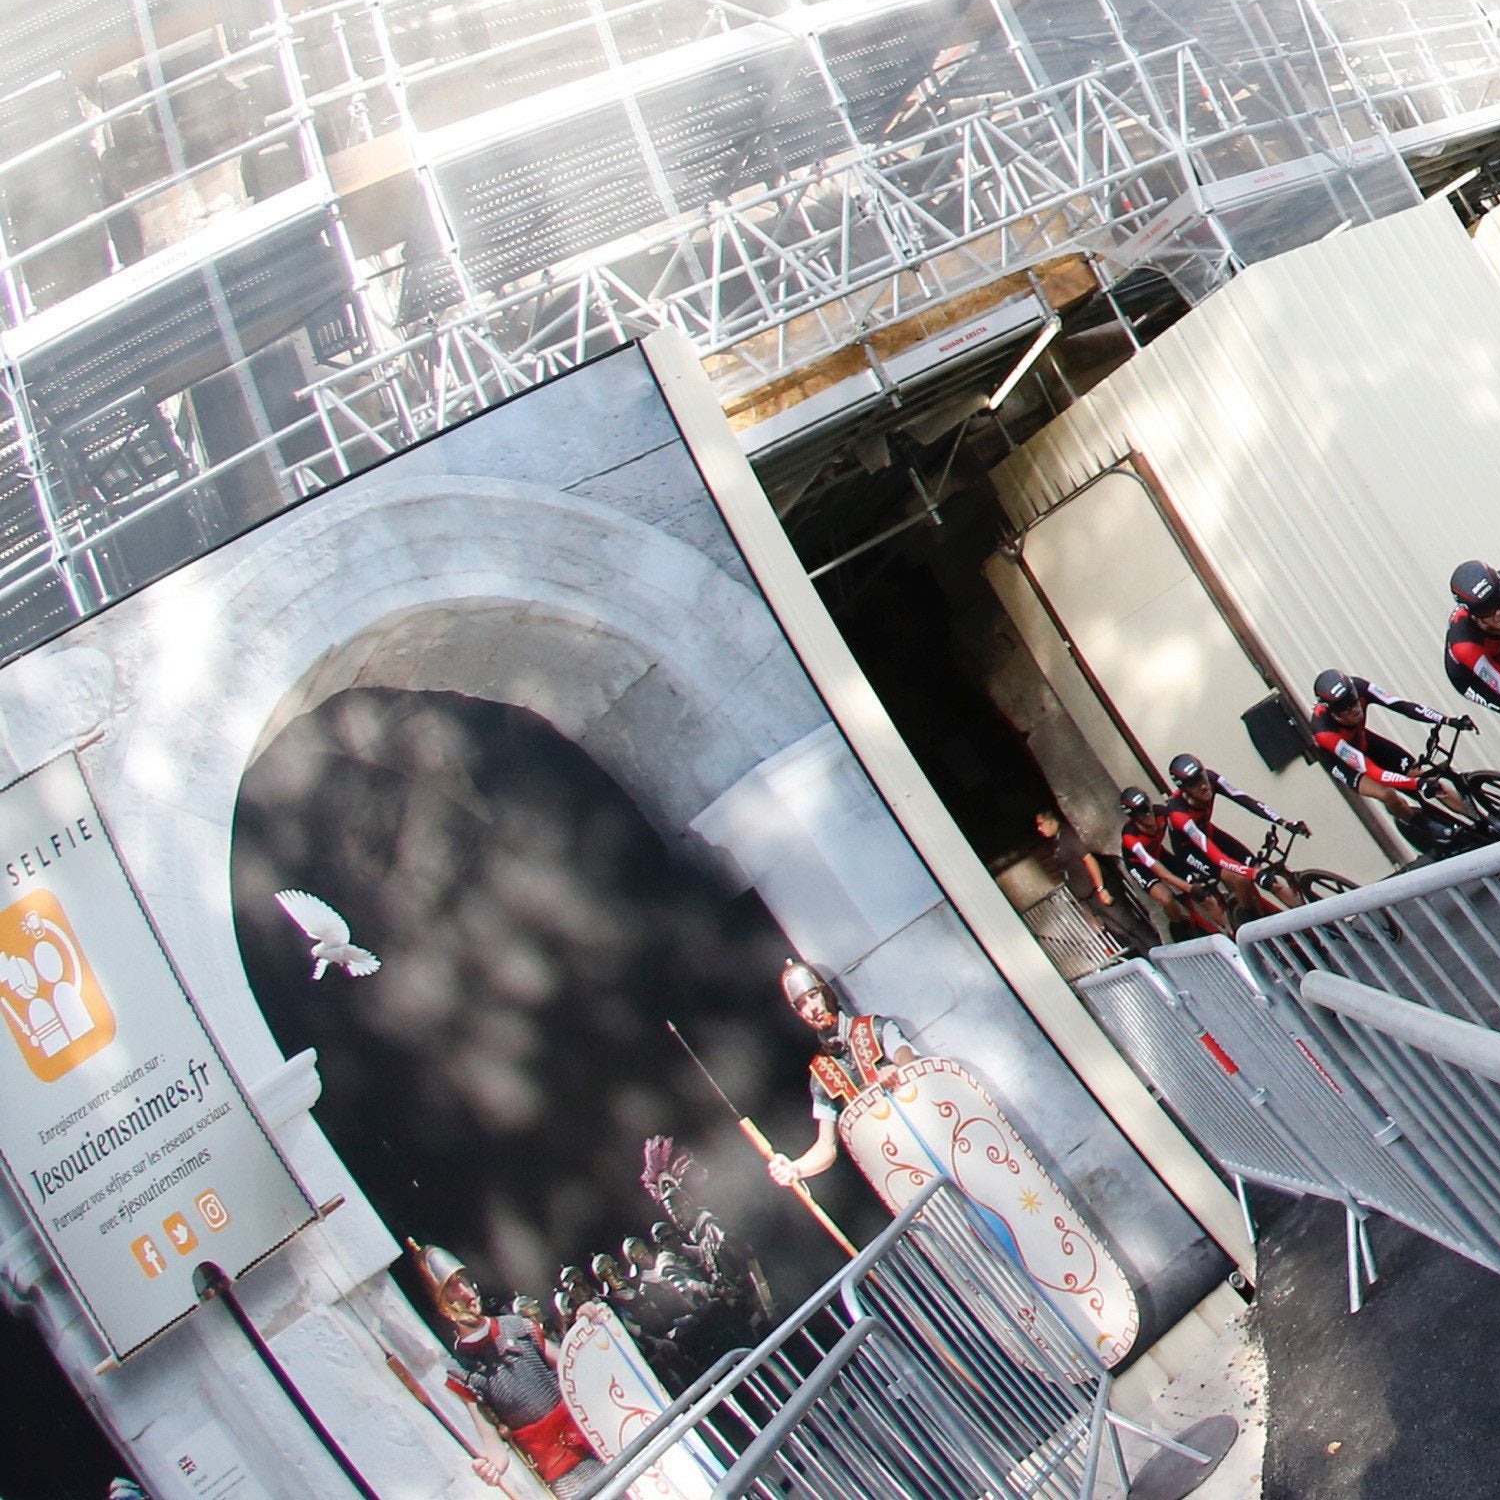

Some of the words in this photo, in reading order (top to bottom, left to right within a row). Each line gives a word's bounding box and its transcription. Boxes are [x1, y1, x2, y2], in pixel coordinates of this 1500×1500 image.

[1464, 686, 1500, 712] BMC
[6, 817, 93, 886] SELFIE
[30, 1058, 211, 1205] Jesoutiensnimes.fr
[38, 1106, 89, 1146] Enregistrez
[87, 1089, 111, 1112] votre
[110, 1066, 145, 1097] soutien
[144, 1057, 161, 1073] sur
[52, 1196, 92, 1232] Partagez
[89, 1190, 107, 1206] vos
[105, 1169, 133, 1197] selfies
[132, 1159, 149, 1177] sur
[145, 1150, 162, 1167] les
[160, 1126, 198, 1157] réseaux
[195, 1100, 233, 1132] sociaux
[99, 1214, 120, 1236] avec
[118, 1148, 212, 1223] #jesoutiensnimes
